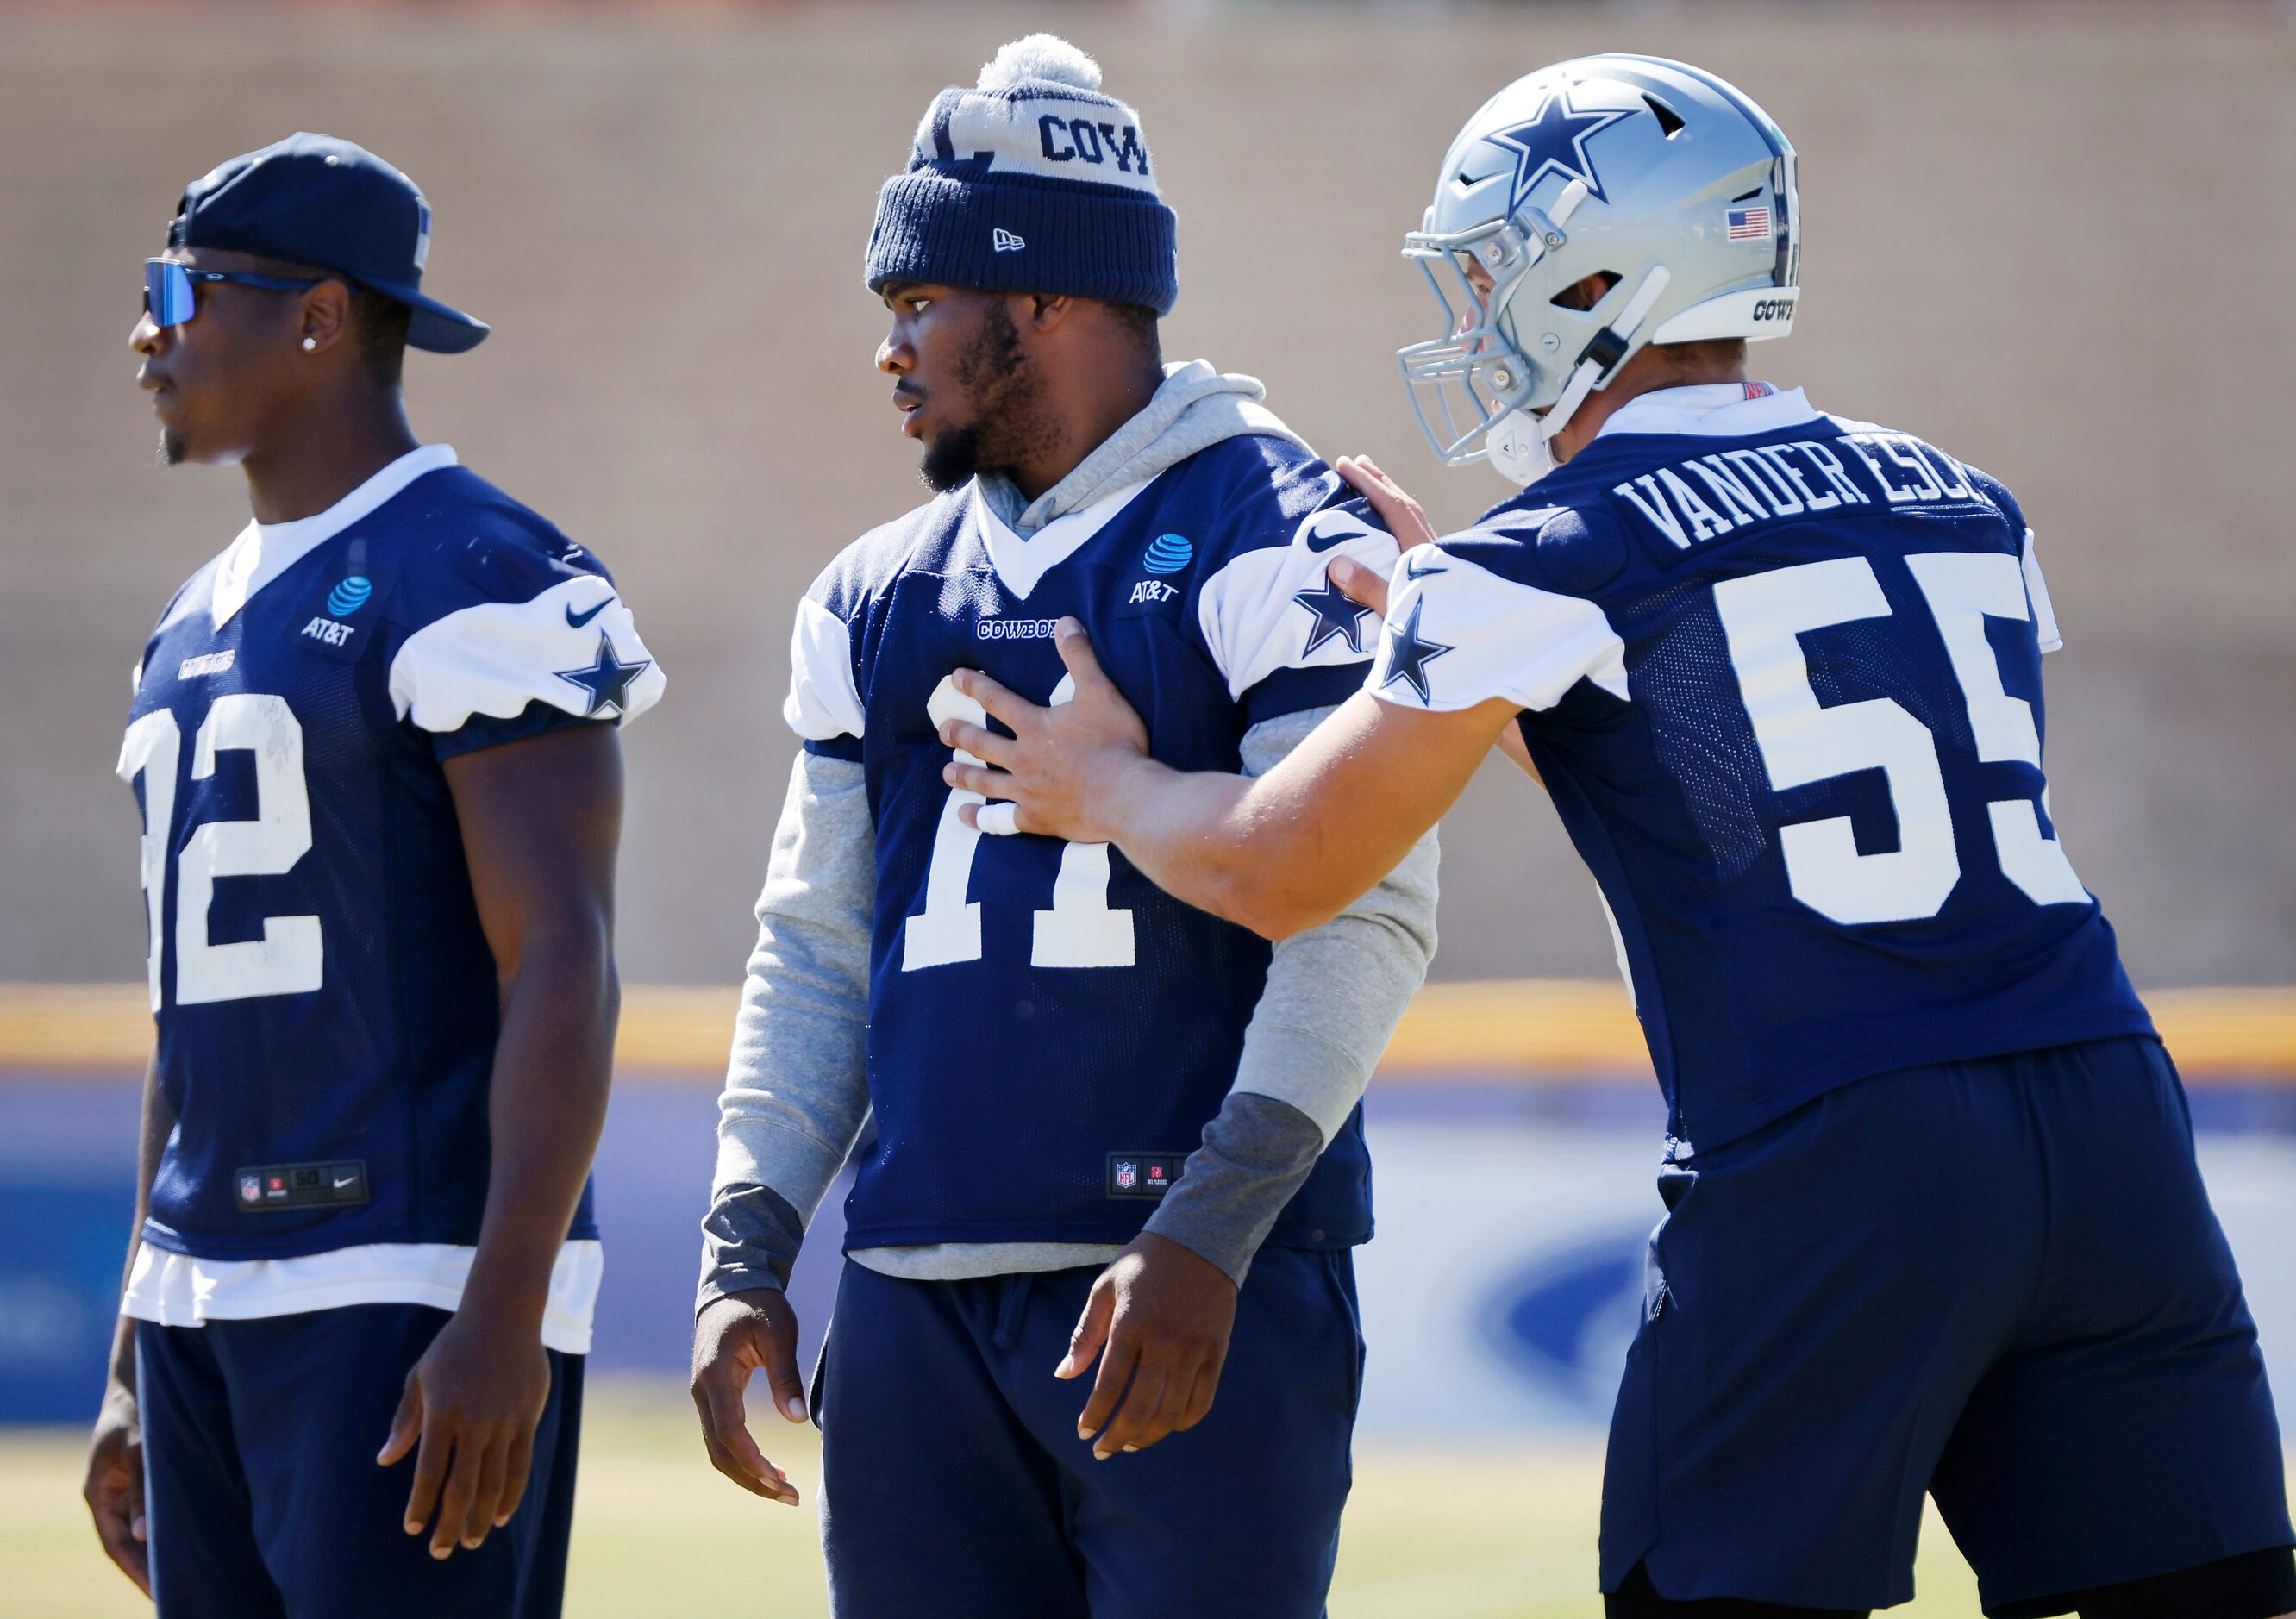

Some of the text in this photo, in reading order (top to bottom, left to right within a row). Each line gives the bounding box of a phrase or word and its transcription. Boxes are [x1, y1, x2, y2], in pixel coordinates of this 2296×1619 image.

[1613, 441, 1871, 550] VANDER
[1129, 580, 1179, 603] AT&T
[301, 616, 355, 647] AT&T
[1713, 552, 2093, 926] 55
